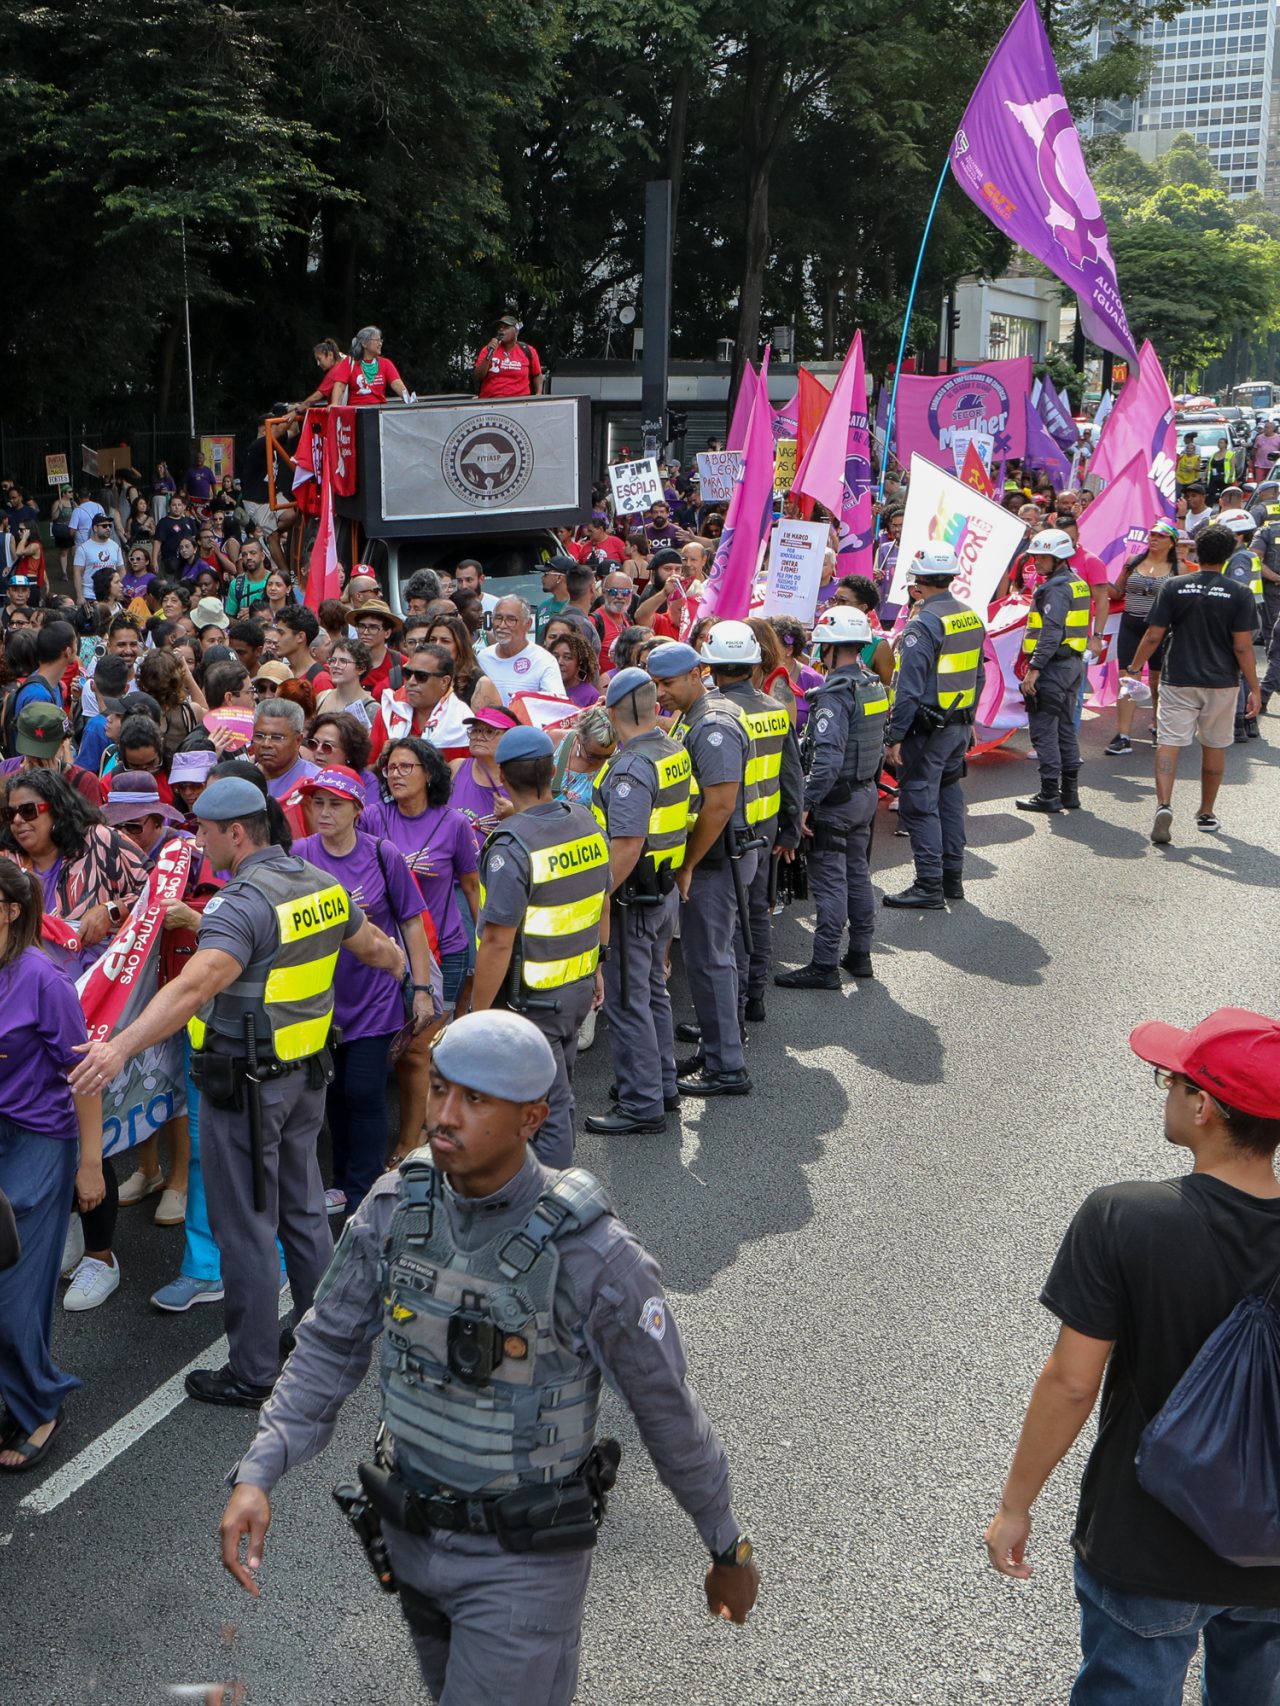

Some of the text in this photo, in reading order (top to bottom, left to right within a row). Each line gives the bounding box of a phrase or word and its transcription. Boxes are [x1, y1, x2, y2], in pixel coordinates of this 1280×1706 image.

[477, 455, 501, 463] FITIASP
[704, 452, 740, 465] ABORT
[778, 448, 796, 457] VAGA
[711, 465, 738, 476] LEGA
[777, 461, 788, 470] AS
[774, 476, 792, 487] CREC
[1147, 451, 1176, 504] MU
[616, 479, 657, 499] ESCALA
[711, 487, 735, 498] MOR
[1127, 529, 1142, 543] ATO
[951, 615, 979, 630] POLÍCIA
[665, 757, 691, 782] POLÍCI
[548, 842, 603, 873] POLÍCIA
[164, 845, 191, 899] SÃO PAUL
[292, 897, 346, 931] POLÍCIA
[120, 906, 160, 985] SÃO PAULO
